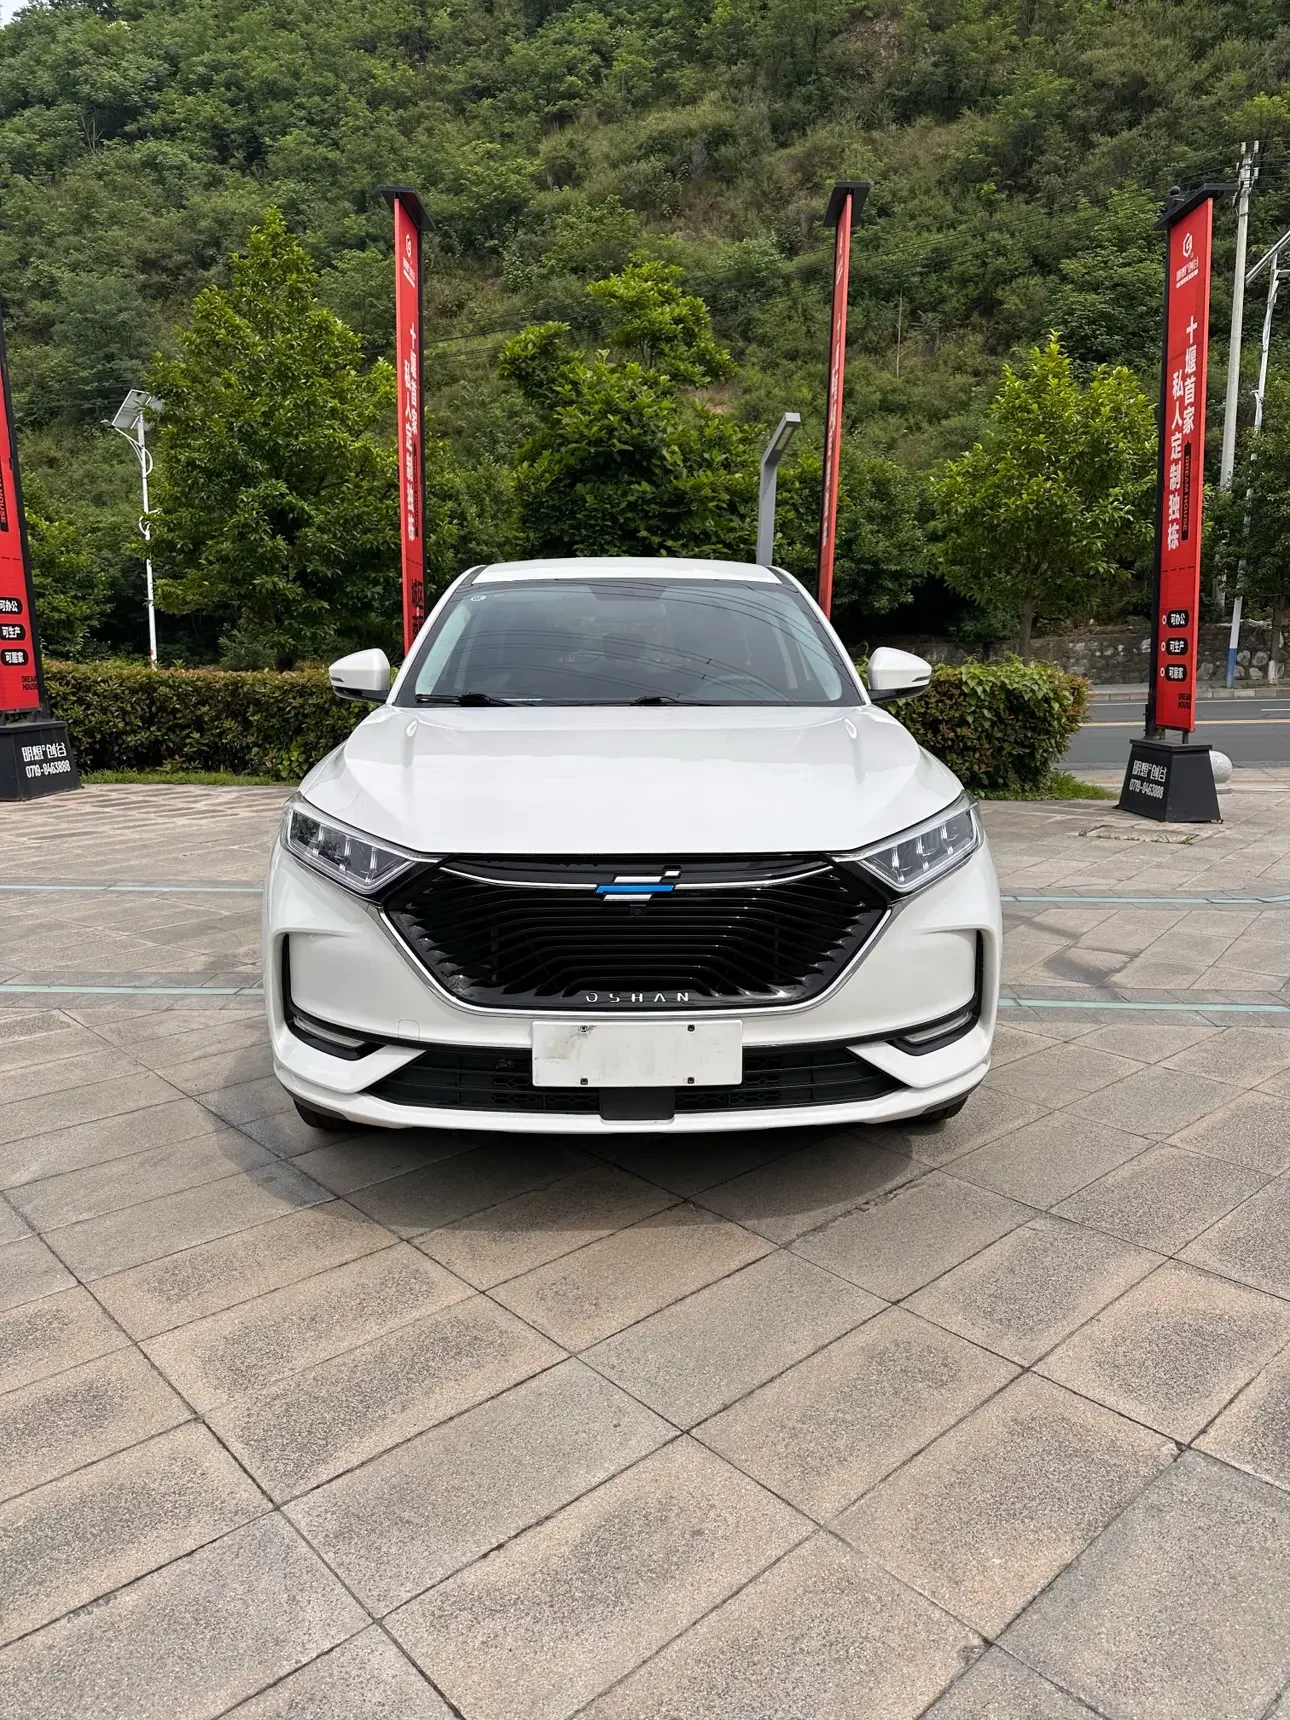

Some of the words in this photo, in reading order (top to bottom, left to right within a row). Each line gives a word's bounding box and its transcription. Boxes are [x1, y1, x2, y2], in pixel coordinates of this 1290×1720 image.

[1183, 316, 1198, 434] 十堰首家
[1168, 369, 1184, 551] 私人定制独栋
[0, 600, 18, 612] 可办公
[1170, 613, 1186, 625] 可办公
[2, 626, 21, 638] 可生产
[1170, 640, 1185, 653] 可生产
[586, 992, 689, 1003] OSHAN
